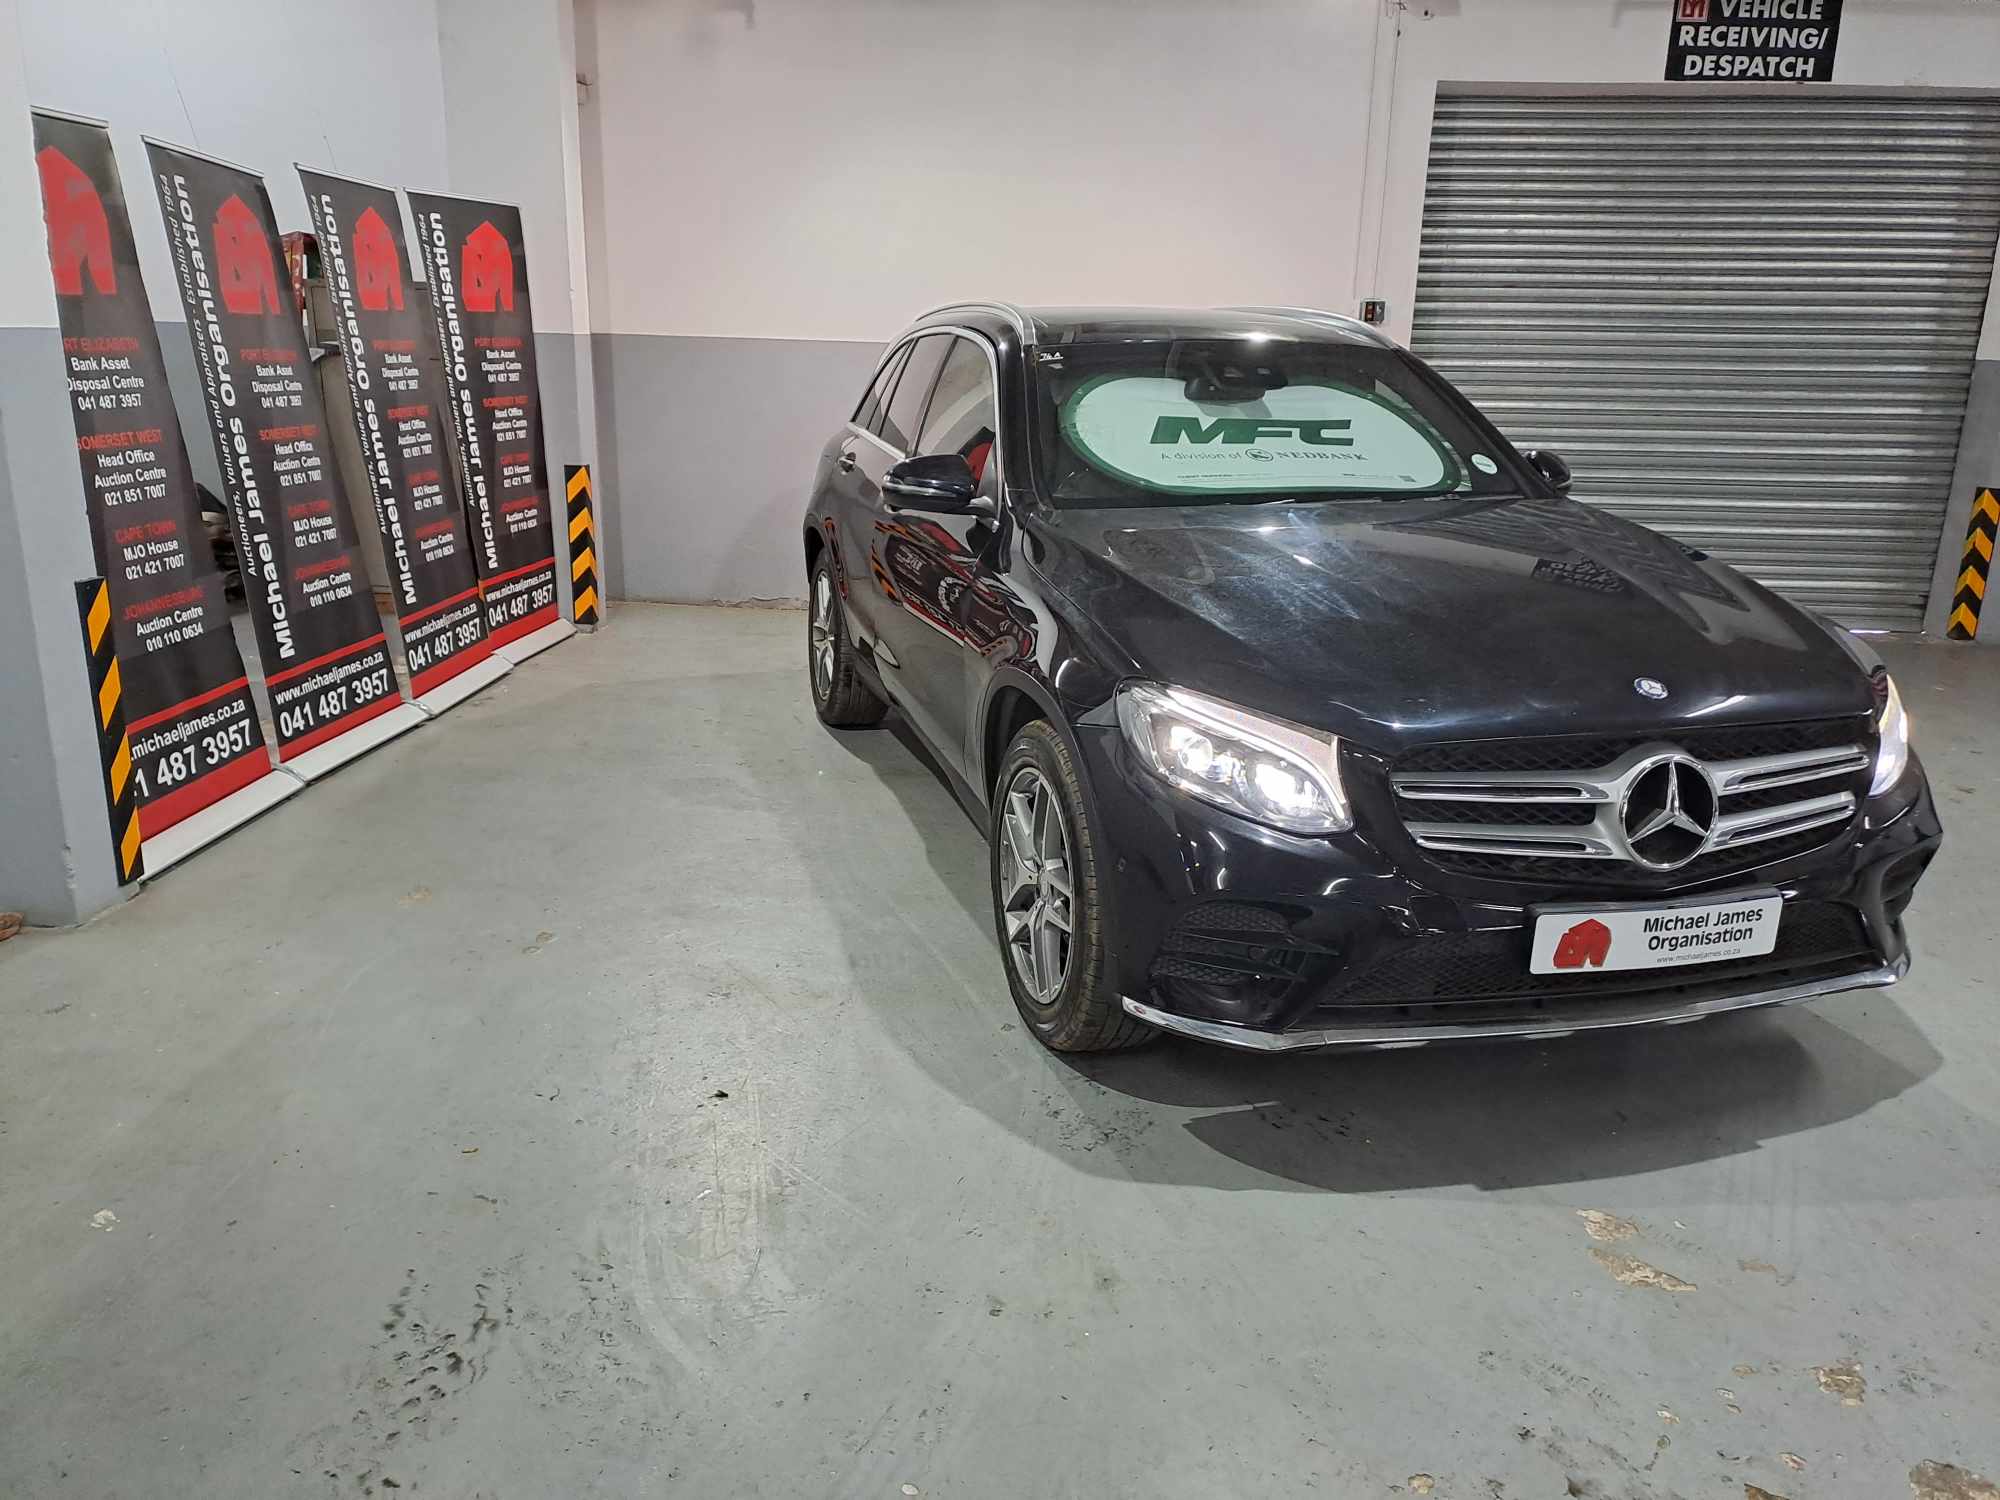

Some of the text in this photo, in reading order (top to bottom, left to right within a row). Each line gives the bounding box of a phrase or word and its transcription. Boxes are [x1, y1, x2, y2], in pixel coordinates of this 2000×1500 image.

[1721, 0, 1824, 19] VEHICLE
[1679, 26, 1830, 49] RECEIVING/
[1683, 55, 1816, 78] DESPATCH
[168, 216, 197, 304] Established
[71, 356, 130, 371] Bank Asset
[193, 319, 217, 397] Appraisers
[112, 375, 144, 389] Centre
[256, 365, 276, 376] Bank
[251, 380, 284, 394] Disposal
[429, 212, 499, 570] Michael James Organisation
[78, 394, 142, 411] 041 487 3957
[320, 194, 417, 605] Michael James Organisation
[173, 174, 295, 660] Michael James Organisation
[210, 399, 224, 428] and
[1149, 416, 1355, 446] MFC
[97, 450, 155, 468] Head Office
[220, 432, 238, 485] Valuers
[273, 459, 301, 471] Auction
[1174, 451, 1225, 461] division
[1228, 451, 1243, 461] of
[1277, 450, 1370, 462] NEDBANK
[94, 467, 167, 488] Auction Centre
[293, 472, 307, 484] 851
[104, 483, 166, 506] 021 851 7007
[311, 515, 333, 530] House
[123, 539, 179, 562] MJO House
[295, 535, 308, 548] 021
[308, 530, 322, 544] 421
[125, 553, 185, 580] 021 421 7007
[303, 578, 329, 594] Auction
[489, 584, 553, 627] 041 487 3957
[136, 605, 204, 637] Auction Centre
[146, 636, 162, 652] 010
[163, 629, 181, 646] 110
[408, 617, 481, 671] 041 487 3957
[275, 651, 384, 705] www.michaeljames.co.za
[280, 668, 388, 737] 041 487 3957
[157, 745, 197, 788] 487
[202, 719, 251, 765] 3957
[1643, 906, 1764, 933] Michael James
[1648, 927, 1754, 951] Organisation
